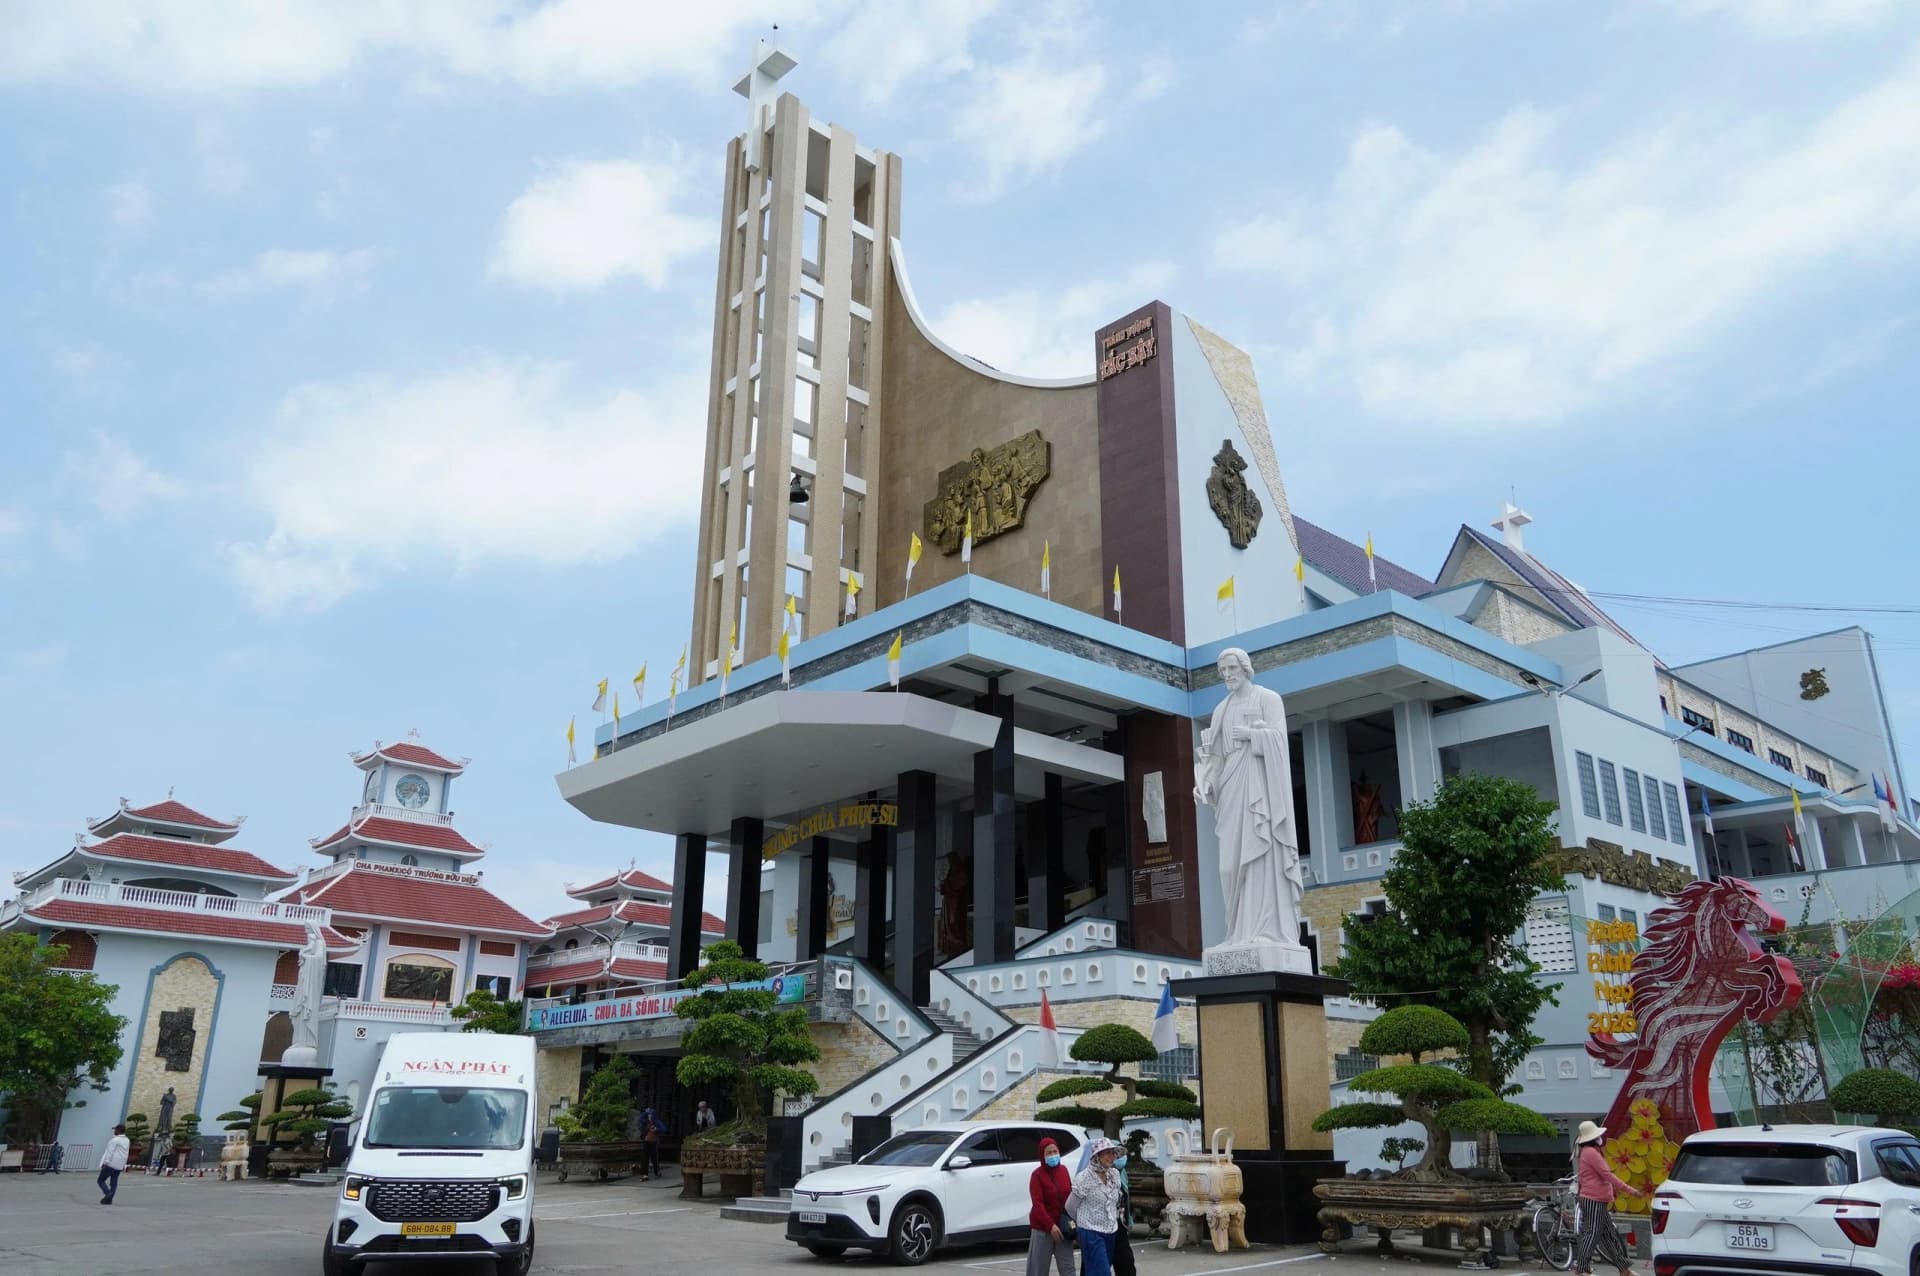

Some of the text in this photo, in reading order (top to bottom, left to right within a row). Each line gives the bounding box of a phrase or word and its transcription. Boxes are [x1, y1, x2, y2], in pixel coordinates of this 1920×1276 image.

[355, 861, 372, 870] CHA
[549, 1008, 587, 1026] ALLELUIA
[1587, 1010, 1638, 1033] 2026
[402, 1059, 512, 1074] NGÂN PHÁT
[1738, 1226, 1759, 1237] 66A
[1730, 1236, 1768, 1248] 201.09
